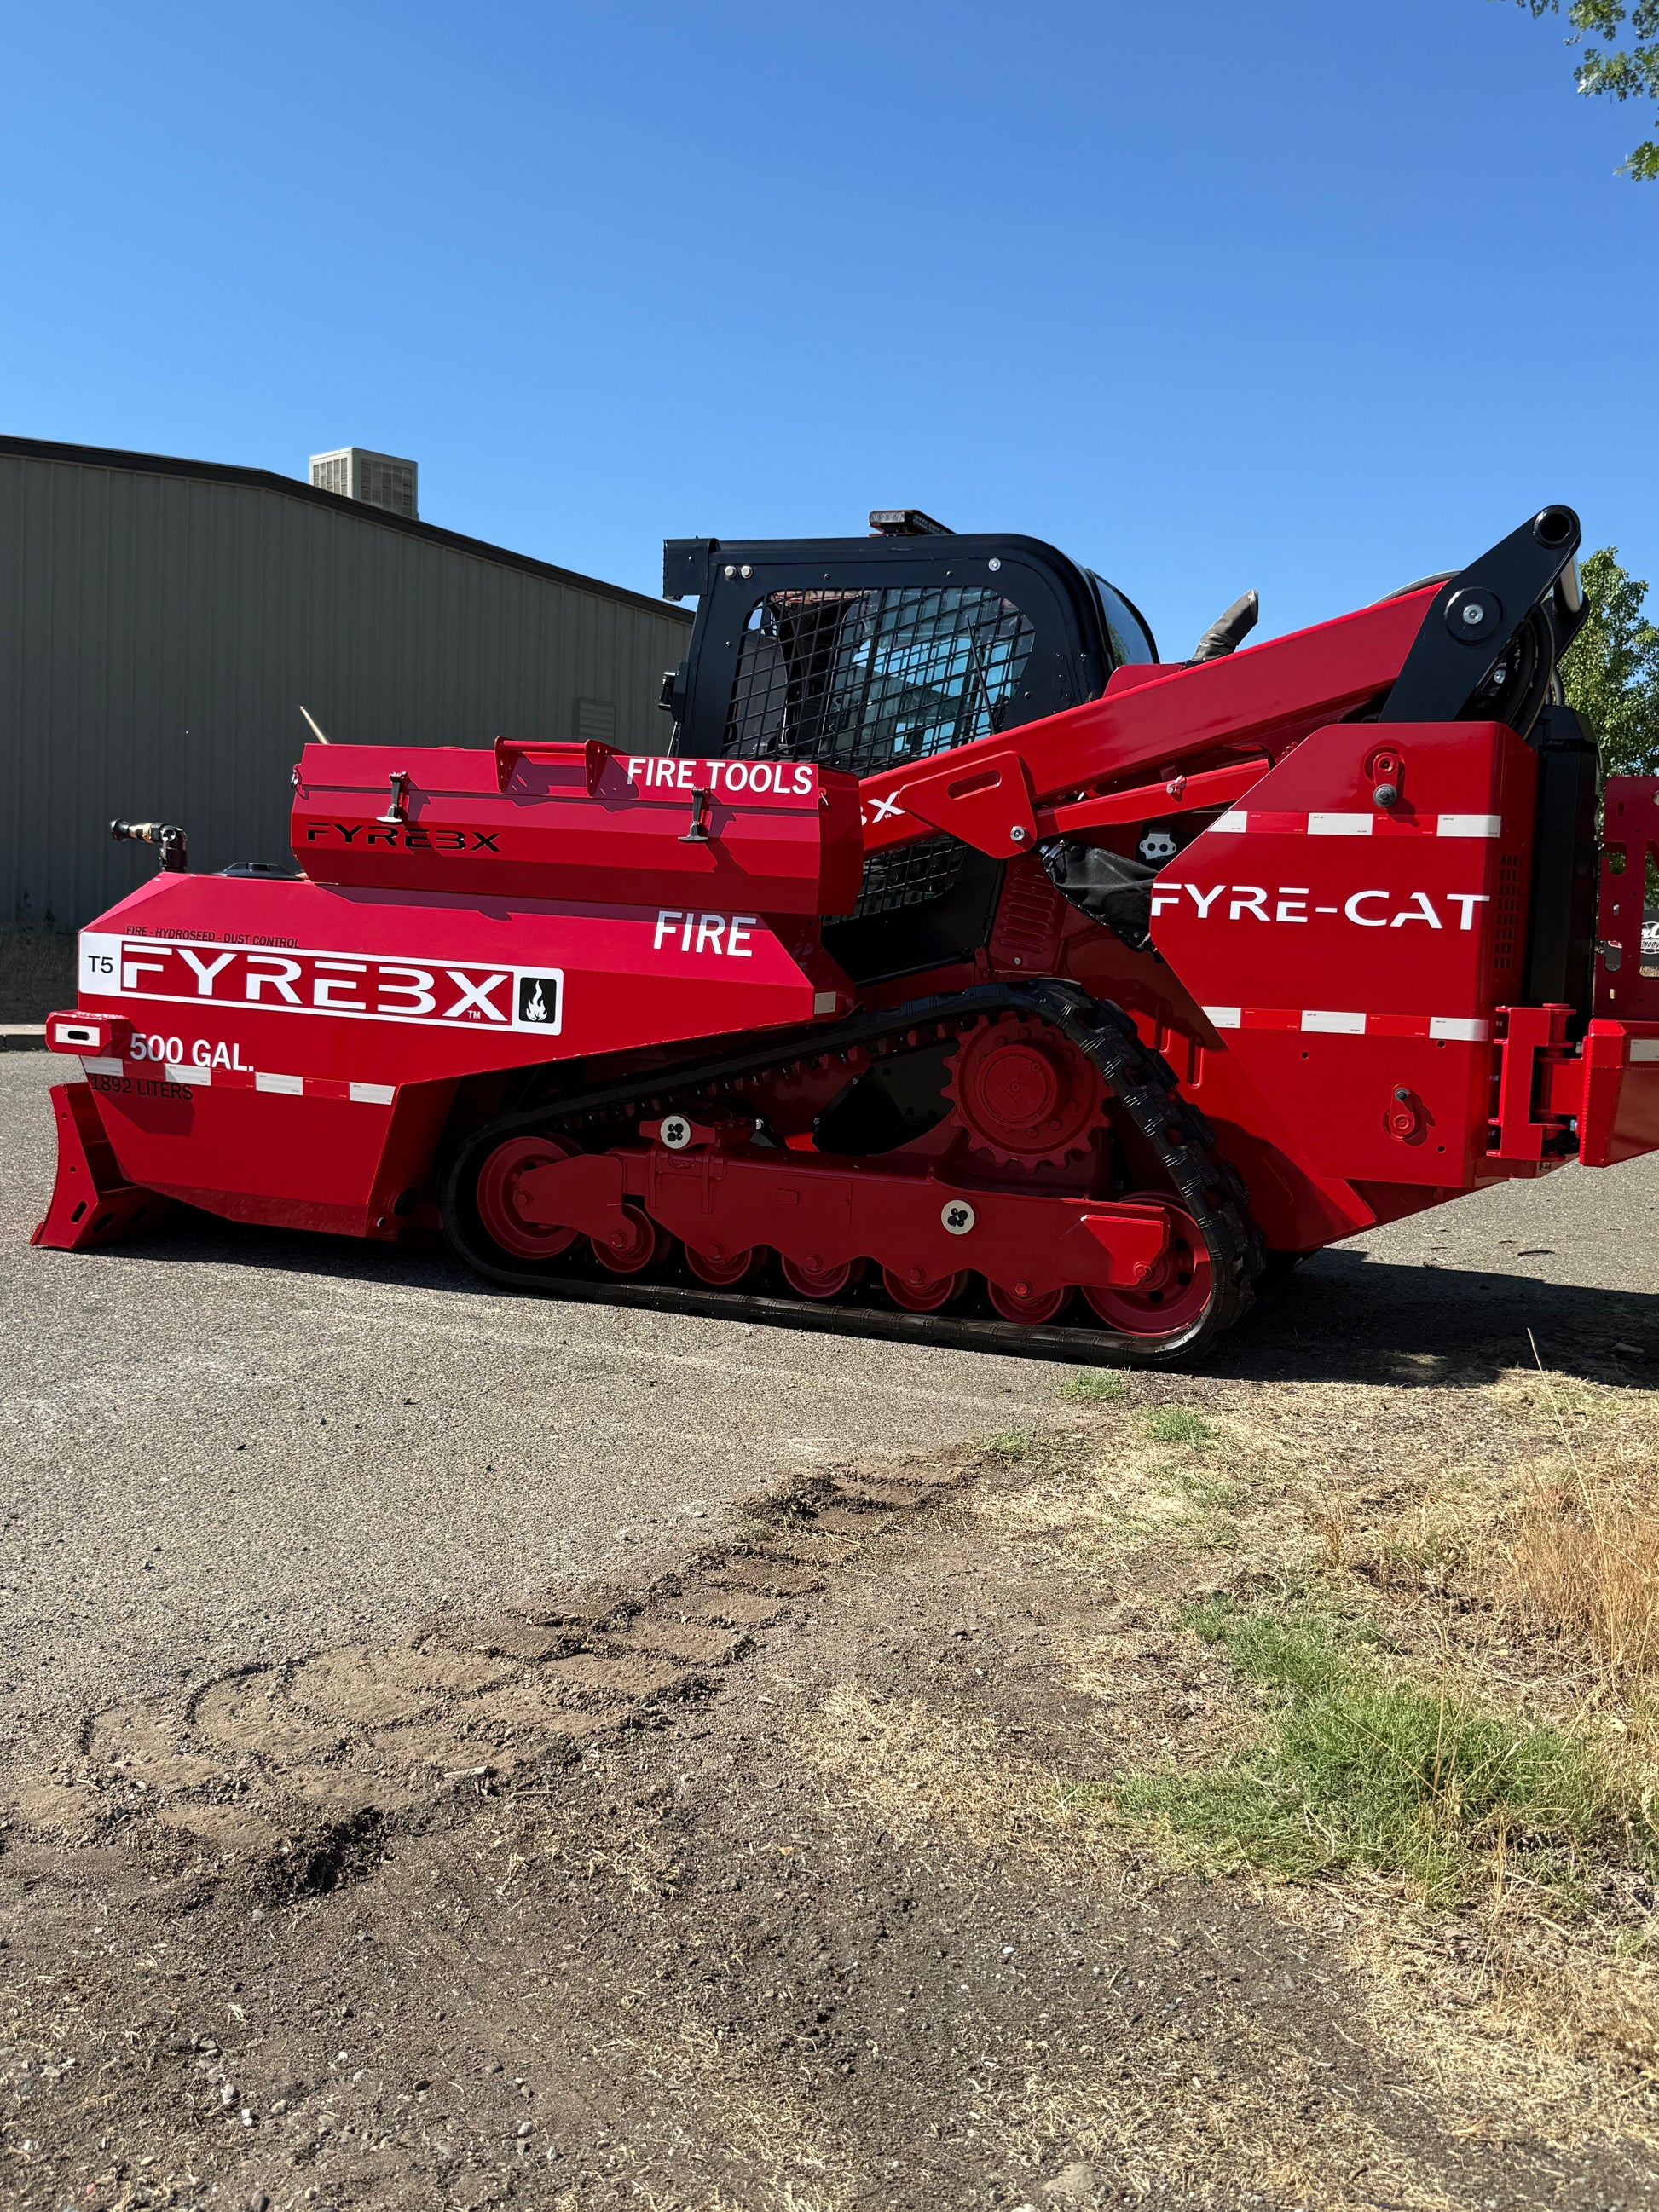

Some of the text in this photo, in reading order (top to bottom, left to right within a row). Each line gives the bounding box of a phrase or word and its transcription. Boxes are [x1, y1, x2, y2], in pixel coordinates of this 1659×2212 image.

[627, 758, 813, 795] FIRE TOOLS
[1151, 882, 1490, 931] FYRE-CAT
[127, 926, 148, 936] FIRE
[155, 927, 216, 942] HYDROSEED
[223, 933, 251, 944] DUST
[252, 935, 300, 948] CONTROL
[653, 910, 757, 957] FIRE
[88, 955, 113, 974] T5
[130, 1033, 255, 1072] 500 GAL.
[91, 1075, 194, 1100] 1892 LITERS
